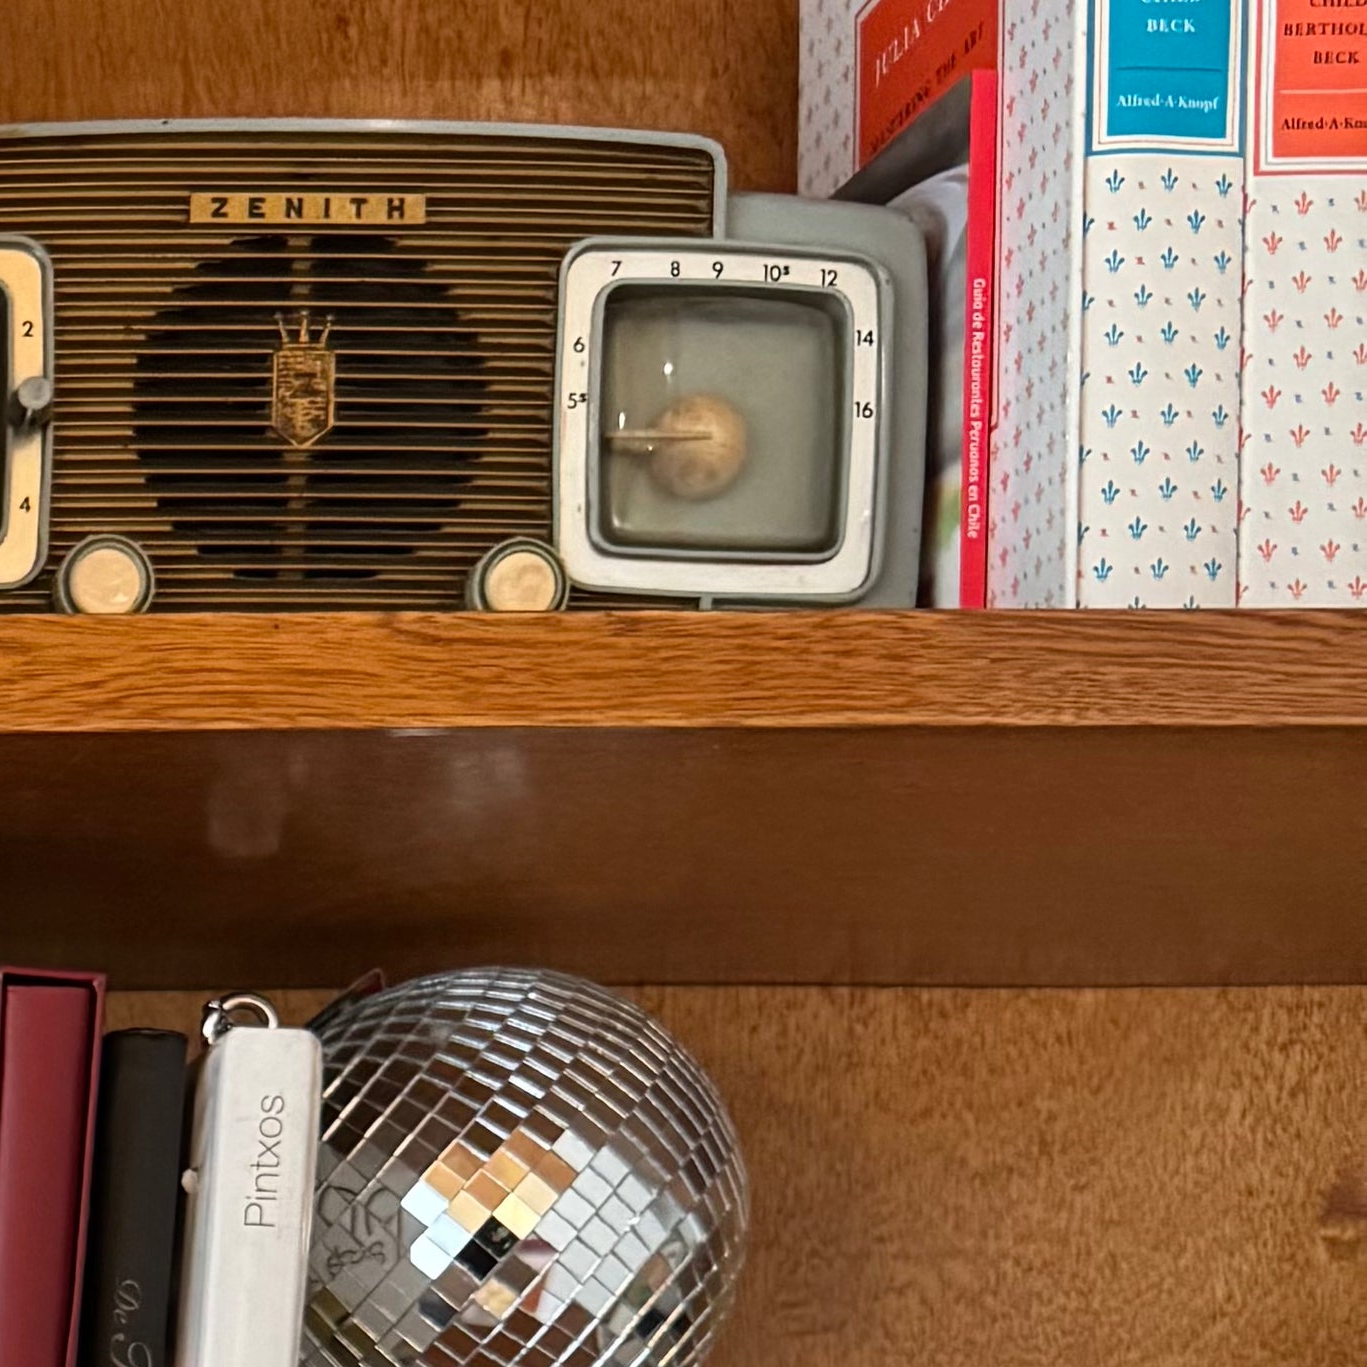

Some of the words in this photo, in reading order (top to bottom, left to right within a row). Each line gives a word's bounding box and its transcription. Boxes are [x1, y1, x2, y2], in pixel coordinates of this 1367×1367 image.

[1146, 18, 1196, 33] BECK
[1313, 51, 1360, 64] BECK
[212, 197, 406, 219] ZENITH
[610, 261, 622, 276] 7
[670, 261, 680, 277] 8
[712, 261, 723, 278] 9
[820, 269, 838, 287] 12
[21, 320, 34, 338] 2
[972, 312, 985, 328] de
[573, 336, 585, 354] 6
[855, 330, 874, 348] 14
[970, 331, 985, 418] Restaurantes
[855, 402, 873, 419] 16
[969, 421, 982, 482] Peruanos
[969, 484, 980, 500] en
[18, 496, 32, 512] 4
[967, 504, 981, 538] Chile
[244, 1095, 285, 1229] Pintxos
[112, 1279, 141, 1328] De
